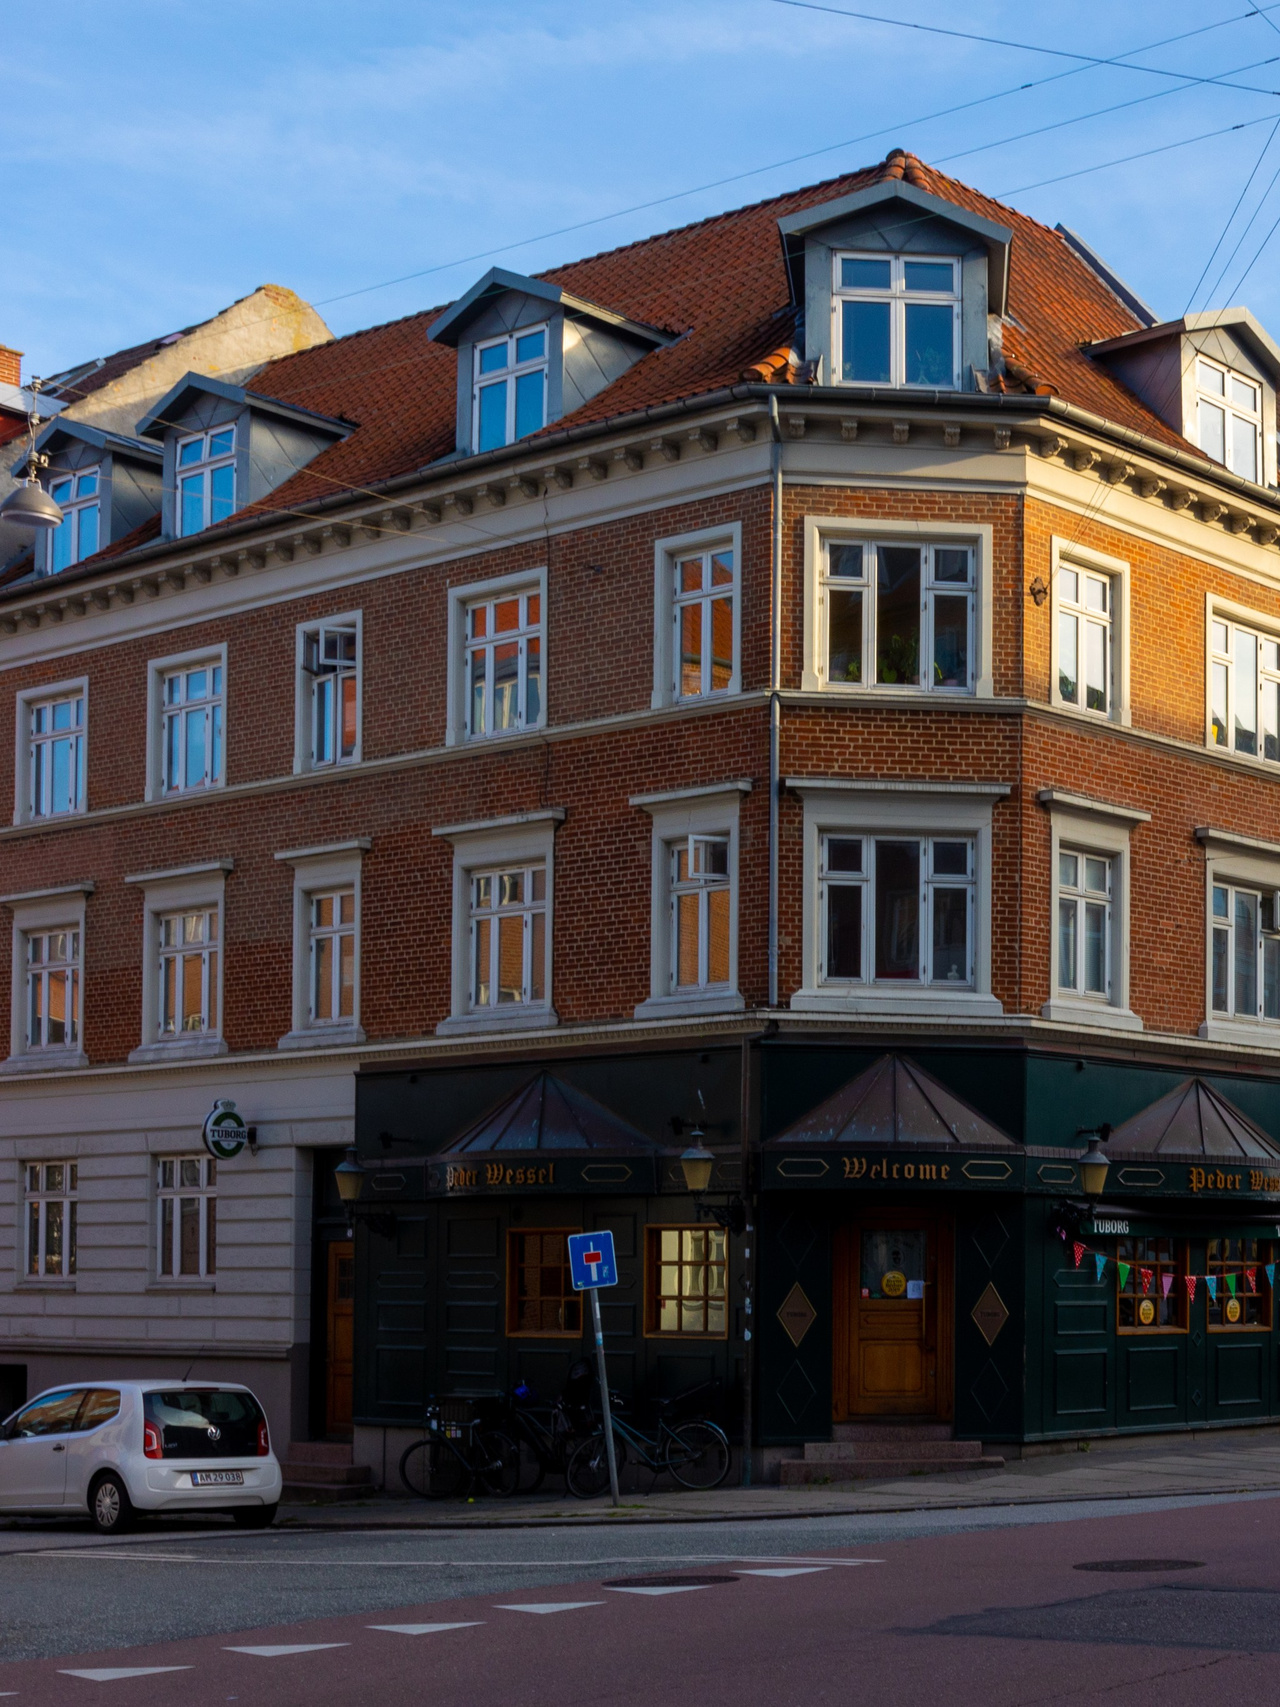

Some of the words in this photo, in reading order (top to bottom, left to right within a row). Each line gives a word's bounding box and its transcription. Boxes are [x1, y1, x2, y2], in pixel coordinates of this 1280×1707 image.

[210, 1129, 247, 1140] TUBORG
[485, 1162, 555, 1185] Wessel
[841, 1157, 950, 1180] Welcome
[1189, 1166, 1241, 1193] Peder
[1093, 1219, 1130, 1234] TUBORG
[200, 1473, 213, 1482] AM
[214, 1473, 223, 1481] 29
[225, 1472, 242, 1482] 038
